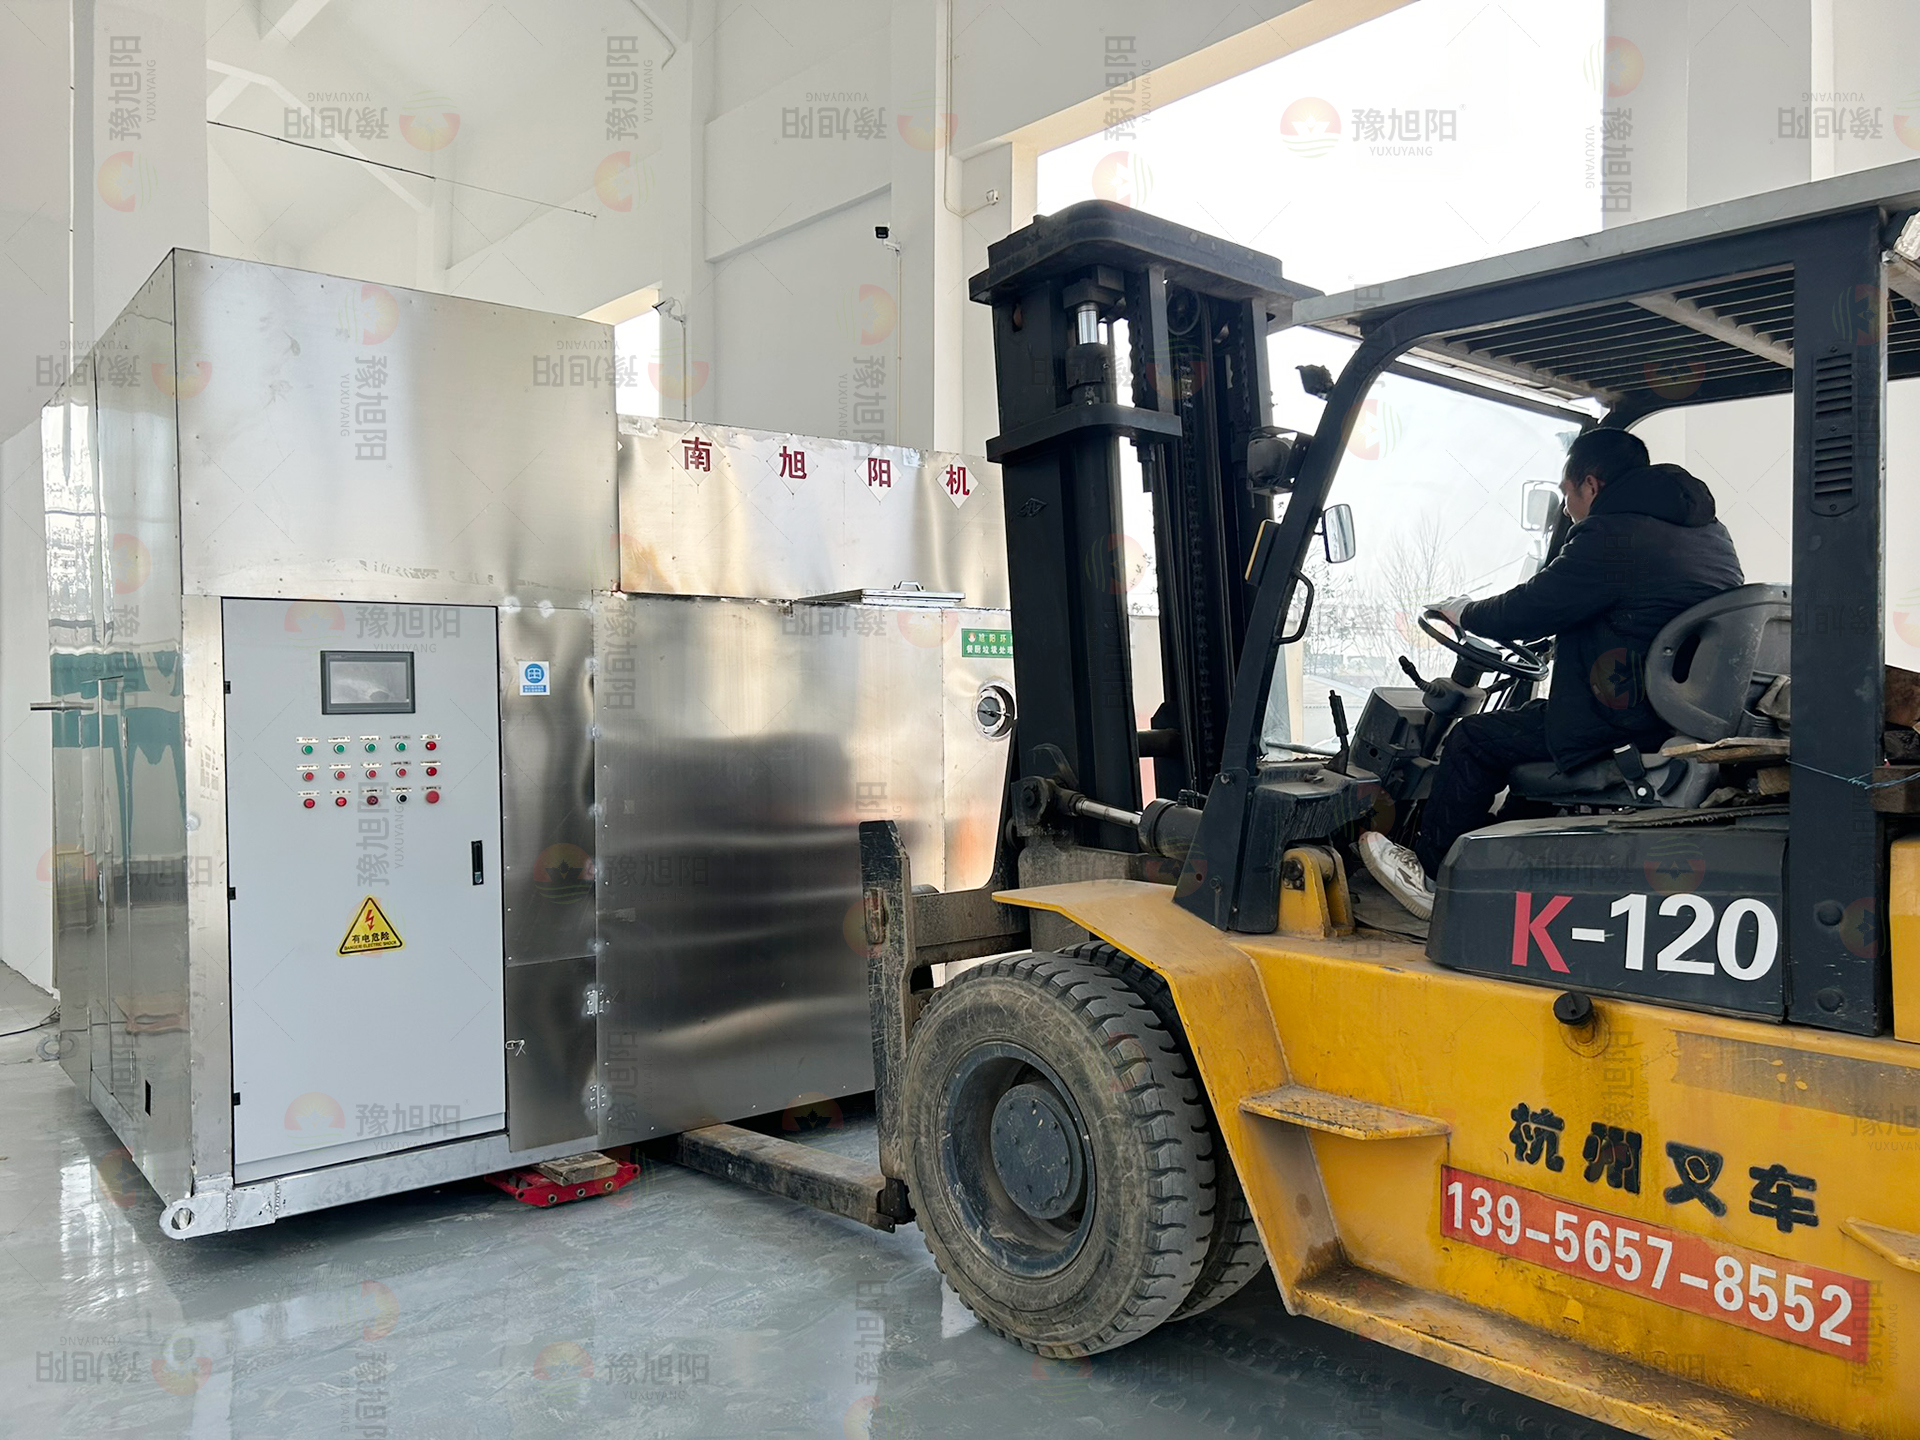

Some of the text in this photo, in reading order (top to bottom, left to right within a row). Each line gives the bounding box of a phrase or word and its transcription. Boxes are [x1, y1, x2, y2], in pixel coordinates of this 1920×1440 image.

[352, 931, 389, 943] 有电危险
[1511, 891, 1779, 981] K-120
[1509, 1102, 1820, 1234] 杭州叉车
[1446, 1181, 1853, 1346] 139-5657-8552
